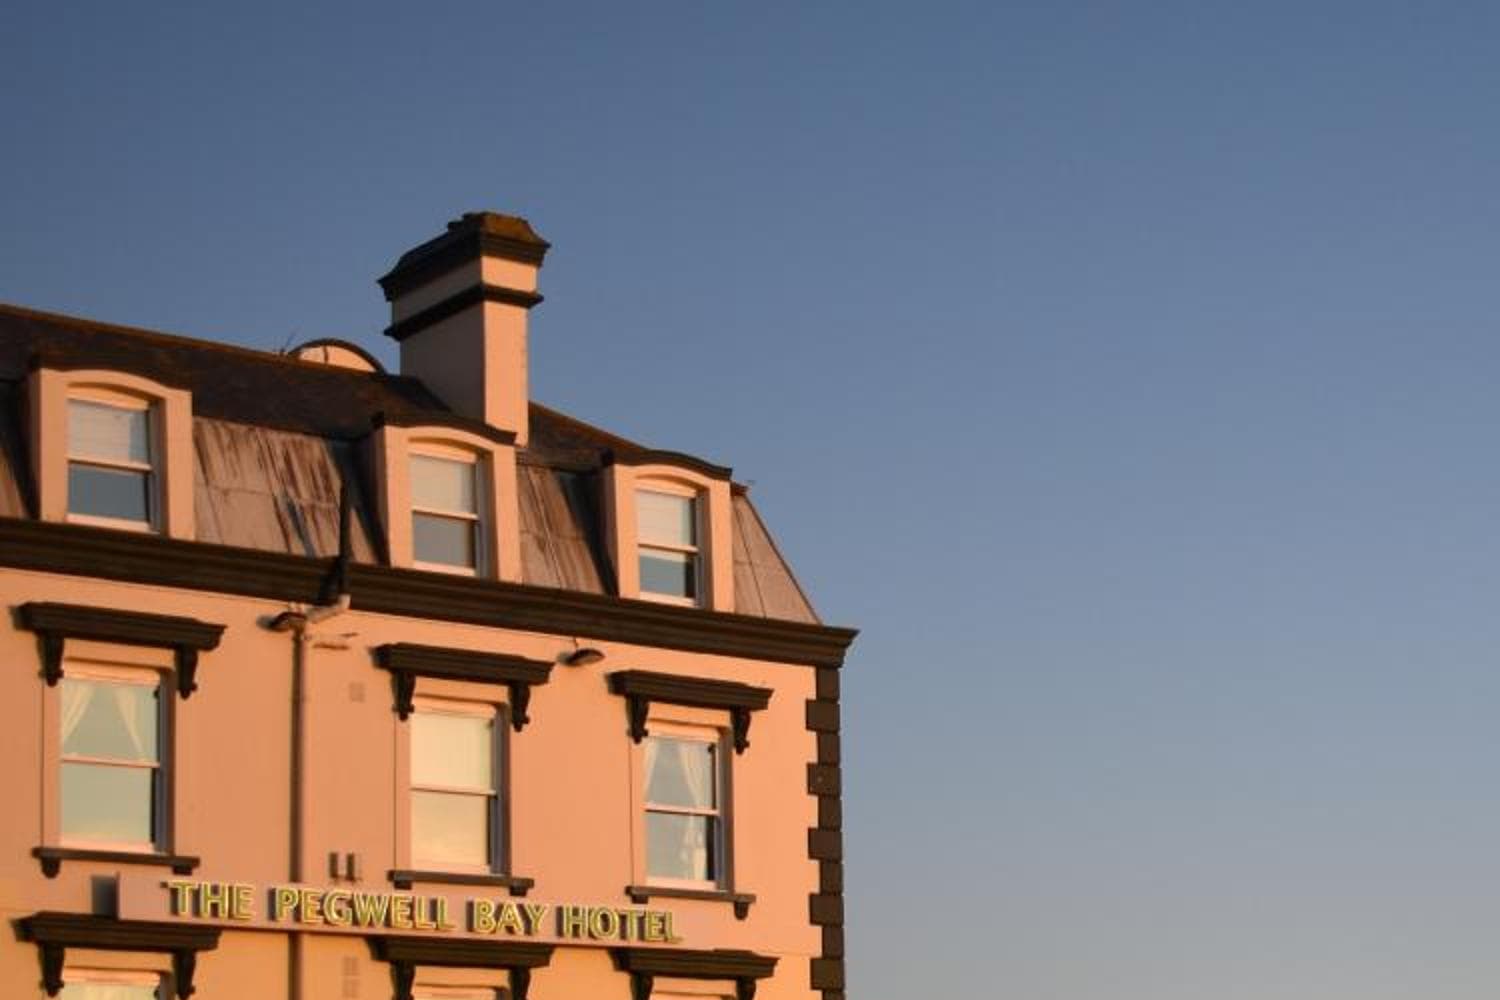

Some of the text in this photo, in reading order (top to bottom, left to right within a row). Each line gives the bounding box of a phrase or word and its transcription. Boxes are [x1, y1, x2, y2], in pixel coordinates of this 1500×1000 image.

[167, 880, 683, 944] THE PEGWELL BAY HOTEL
